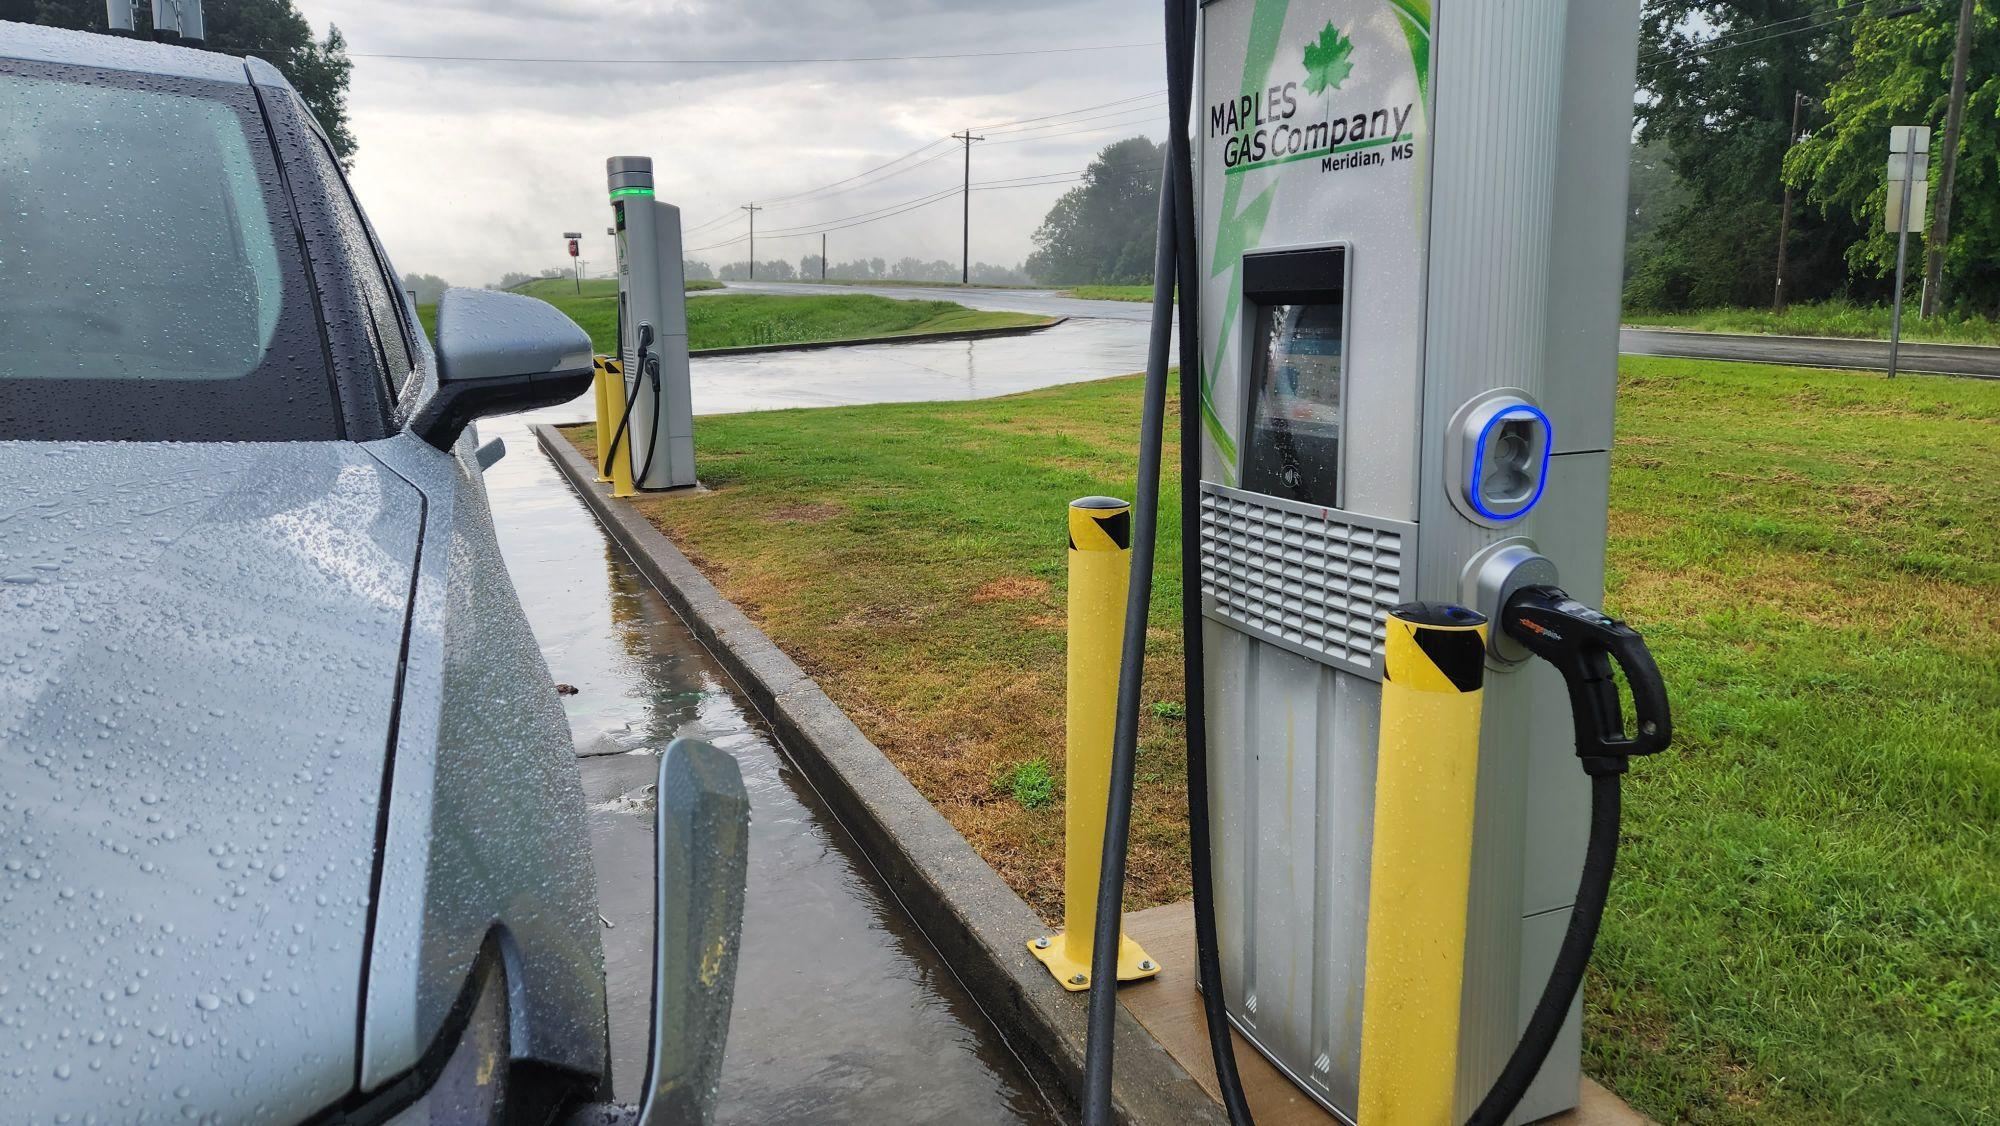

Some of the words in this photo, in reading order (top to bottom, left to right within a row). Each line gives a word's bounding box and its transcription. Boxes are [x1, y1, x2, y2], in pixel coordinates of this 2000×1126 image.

[1211, 82, 1297, 138] MAPLES
[1224, 130, 1267, 167] GAS
[1271, 103, 1413, 157] Company
[1322, 151, 1385, 173] Meridian,
[1391, 143, 1414, 162] MS
